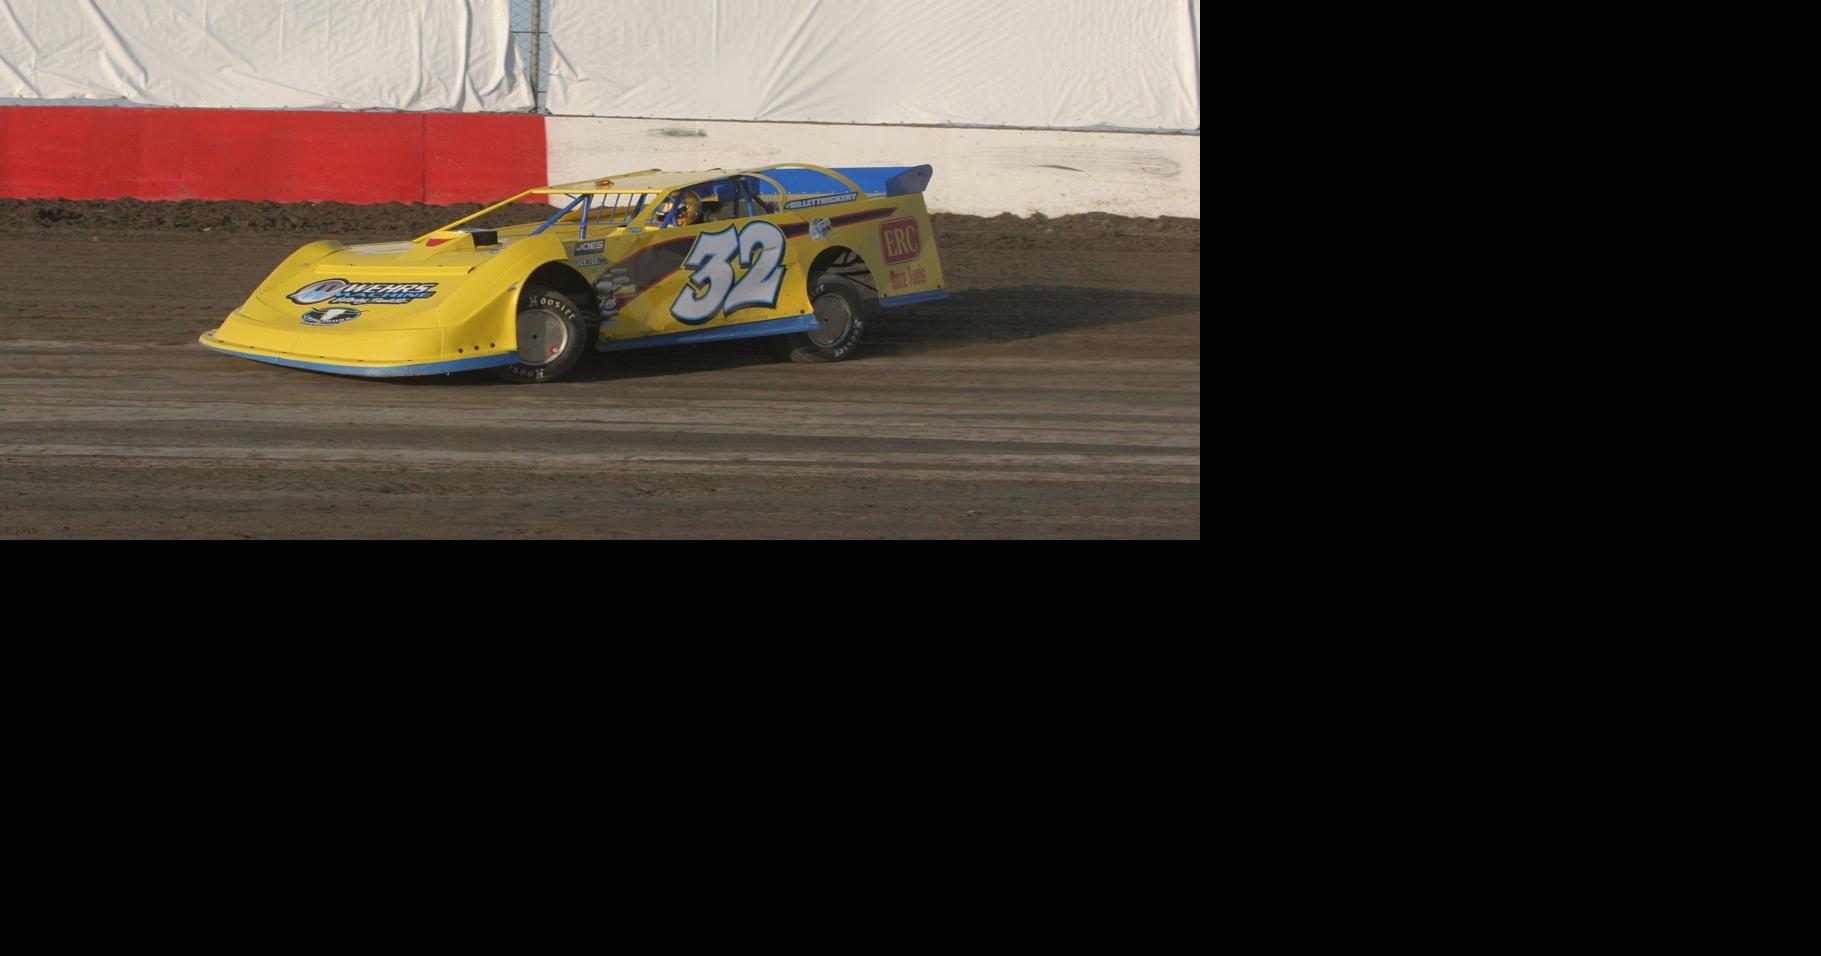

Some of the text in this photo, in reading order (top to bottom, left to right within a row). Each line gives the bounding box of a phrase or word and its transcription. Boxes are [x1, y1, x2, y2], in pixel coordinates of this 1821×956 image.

[576, 240, 604, 252] JOES
[883, 225, 919, 257] ERC
[670, 220, 787, 325] 32
[334, 291, 434, 299] MACHINE
[343, 283, 437, 293] WEHRS
[528, 295, 577, 320] Hoosier
